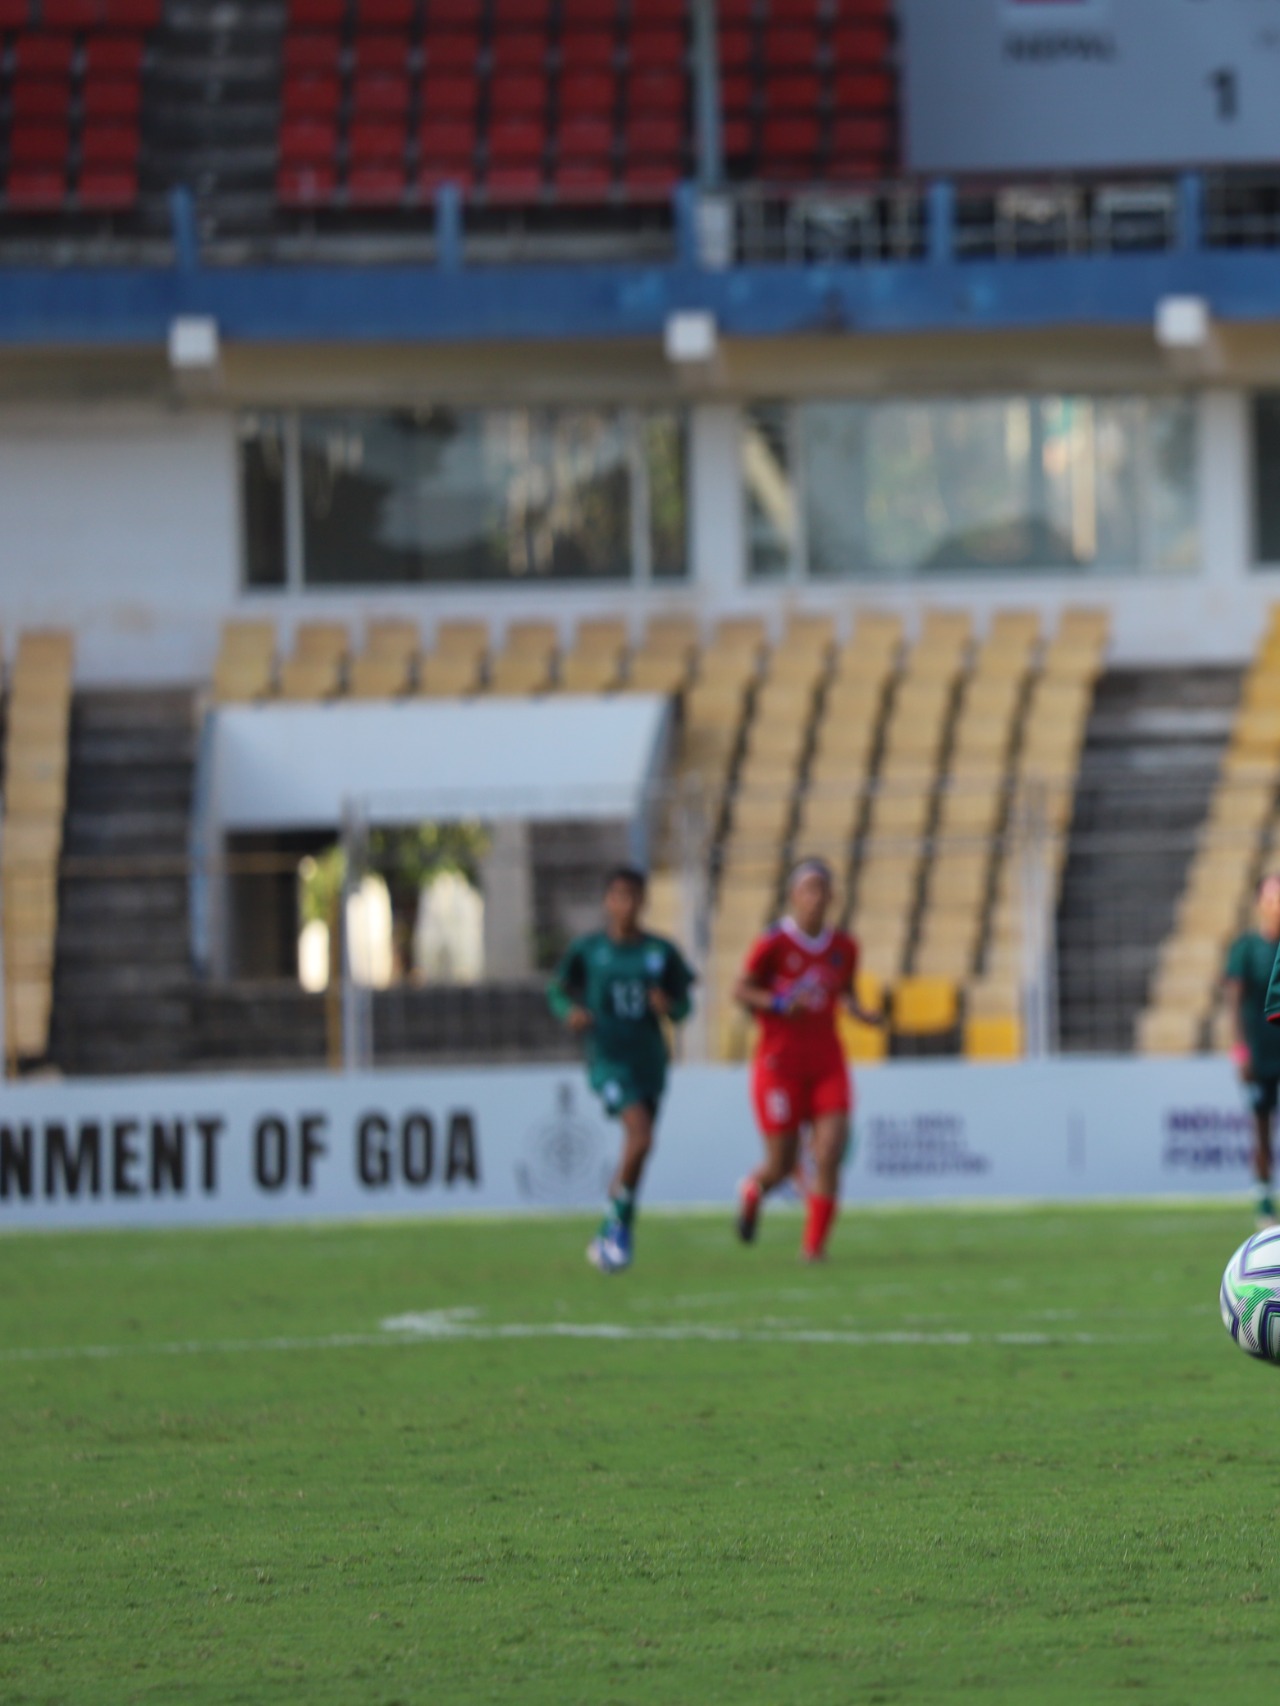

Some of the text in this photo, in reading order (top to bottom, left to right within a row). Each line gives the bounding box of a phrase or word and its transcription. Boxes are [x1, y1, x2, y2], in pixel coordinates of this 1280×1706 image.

[1005, 33, 1114, 60] NEPAL
[1210, 66, 1237, 119] 1
[0, 1109, 479, 1197] NMENT OF GOA
